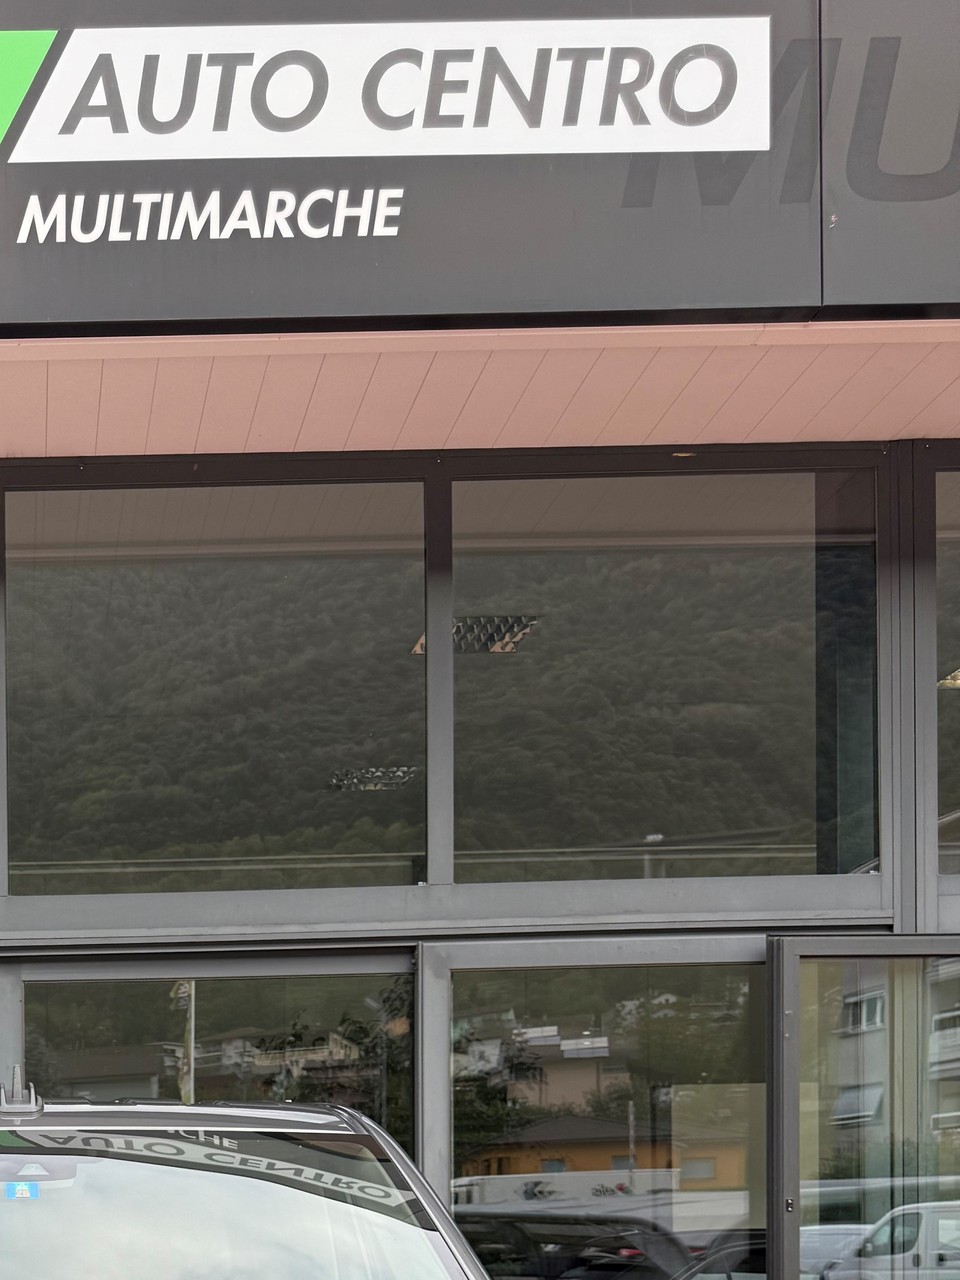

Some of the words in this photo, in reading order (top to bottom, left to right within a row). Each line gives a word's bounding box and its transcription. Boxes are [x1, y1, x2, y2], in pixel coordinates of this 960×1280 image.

[58, 50, 330, 136] AUTO
[360, 43, 739, 130] CENTRO
[16, 187, 404, 244] MULTIMARCHE
